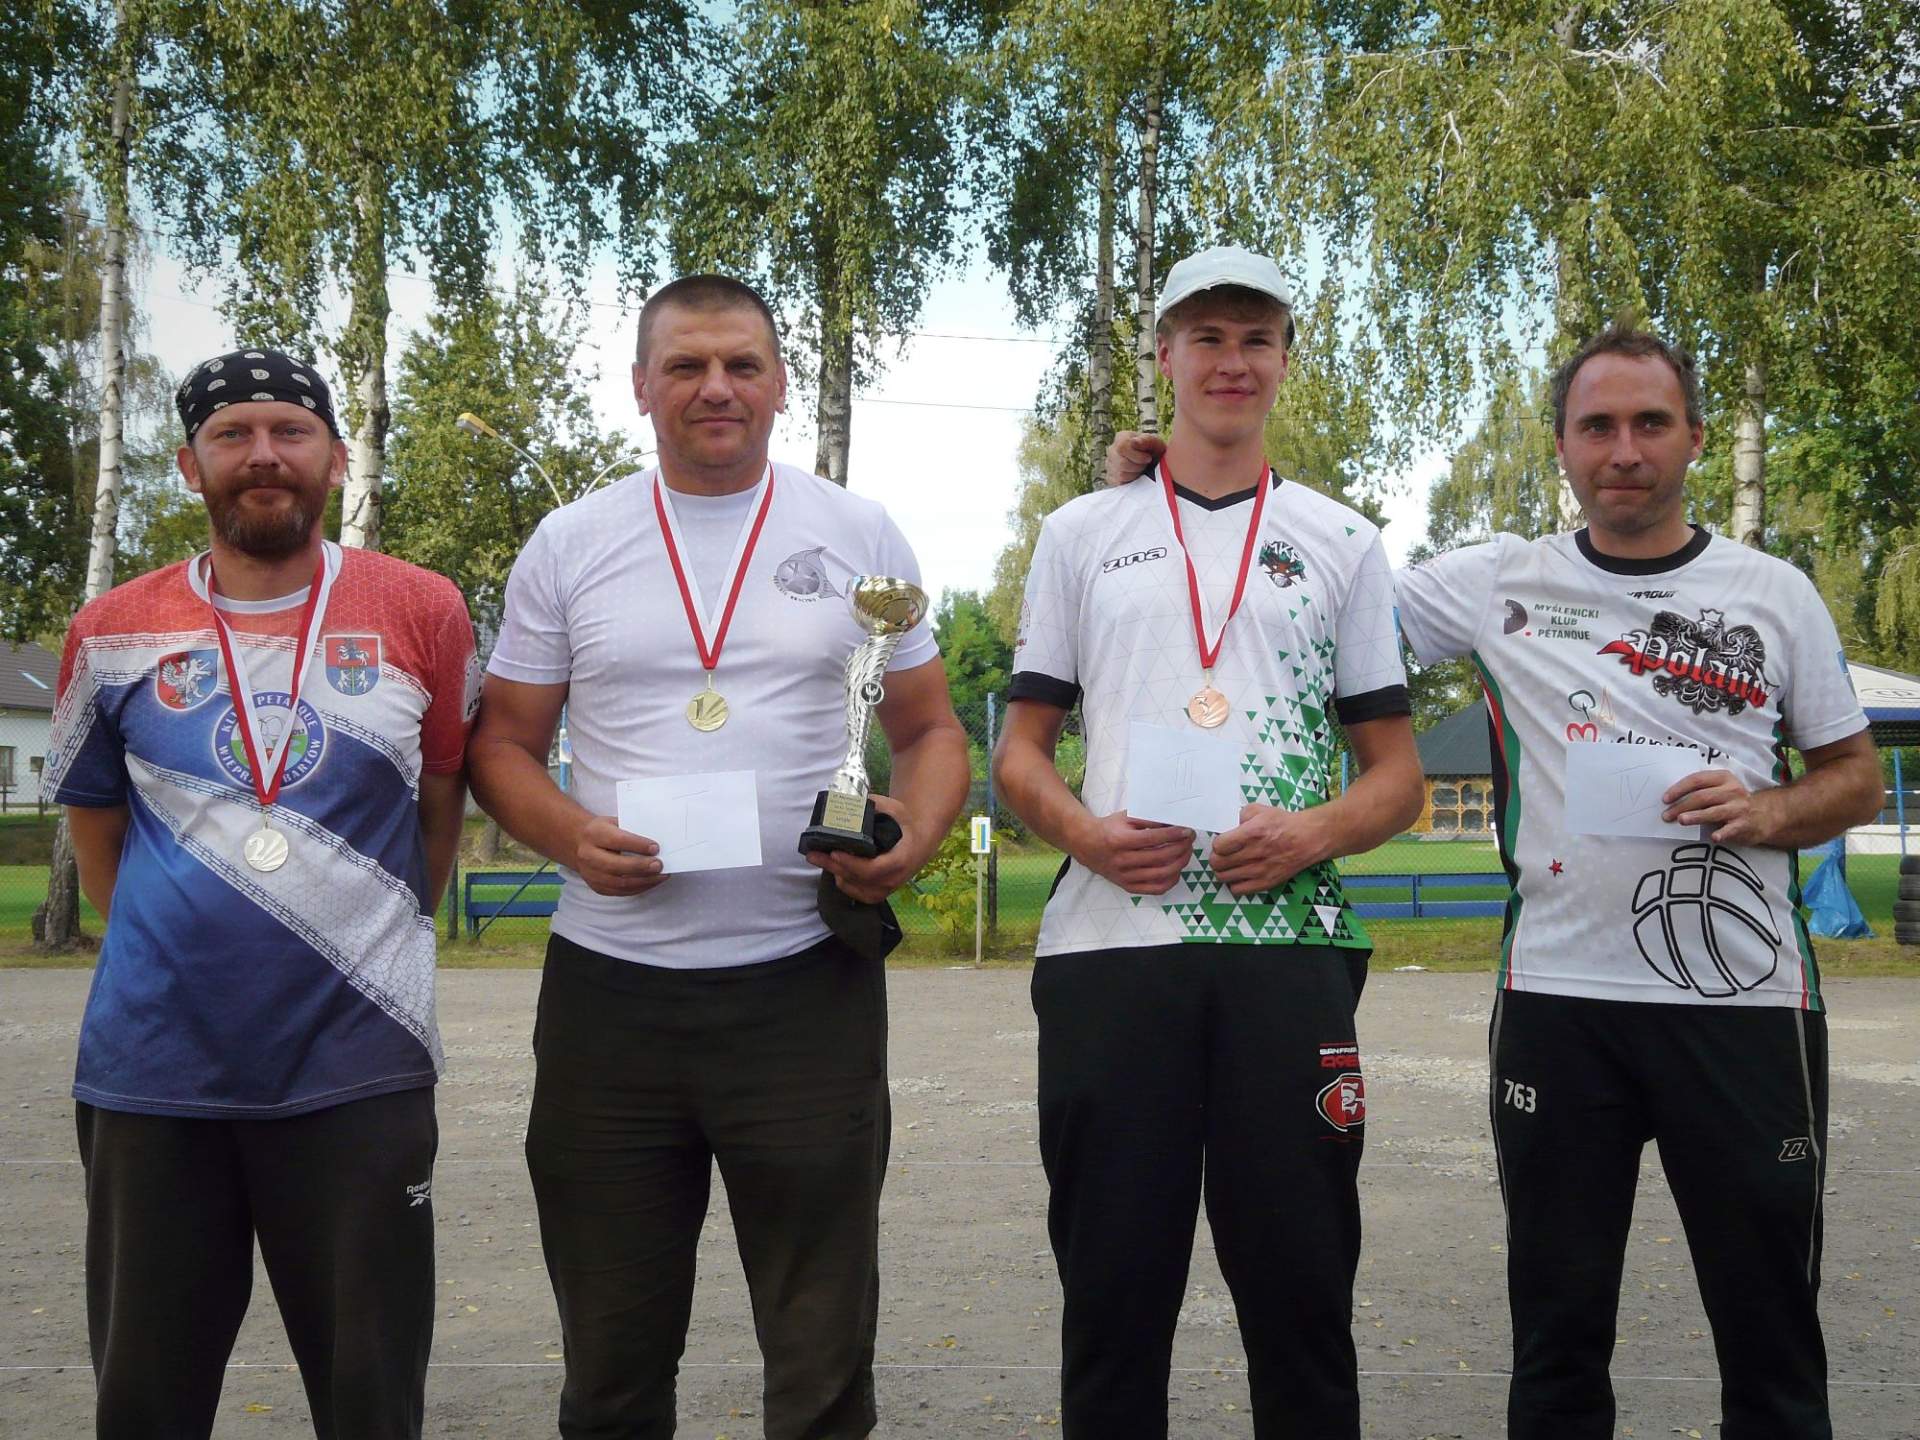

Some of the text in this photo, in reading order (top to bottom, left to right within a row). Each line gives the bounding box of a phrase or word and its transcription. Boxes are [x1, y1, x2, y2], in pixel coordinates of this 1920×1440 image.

[1534, 603, 1600, 619] MYŚLENICKI
[1550, 615, 1579, 626] KLUB
[1598, 630, 1769, 708] Poland
[256, 694, 319, 728] PETAQUE
[218, 744, 255, 784] WIEPR
[1504, 1079, 1537, 1113] 763
